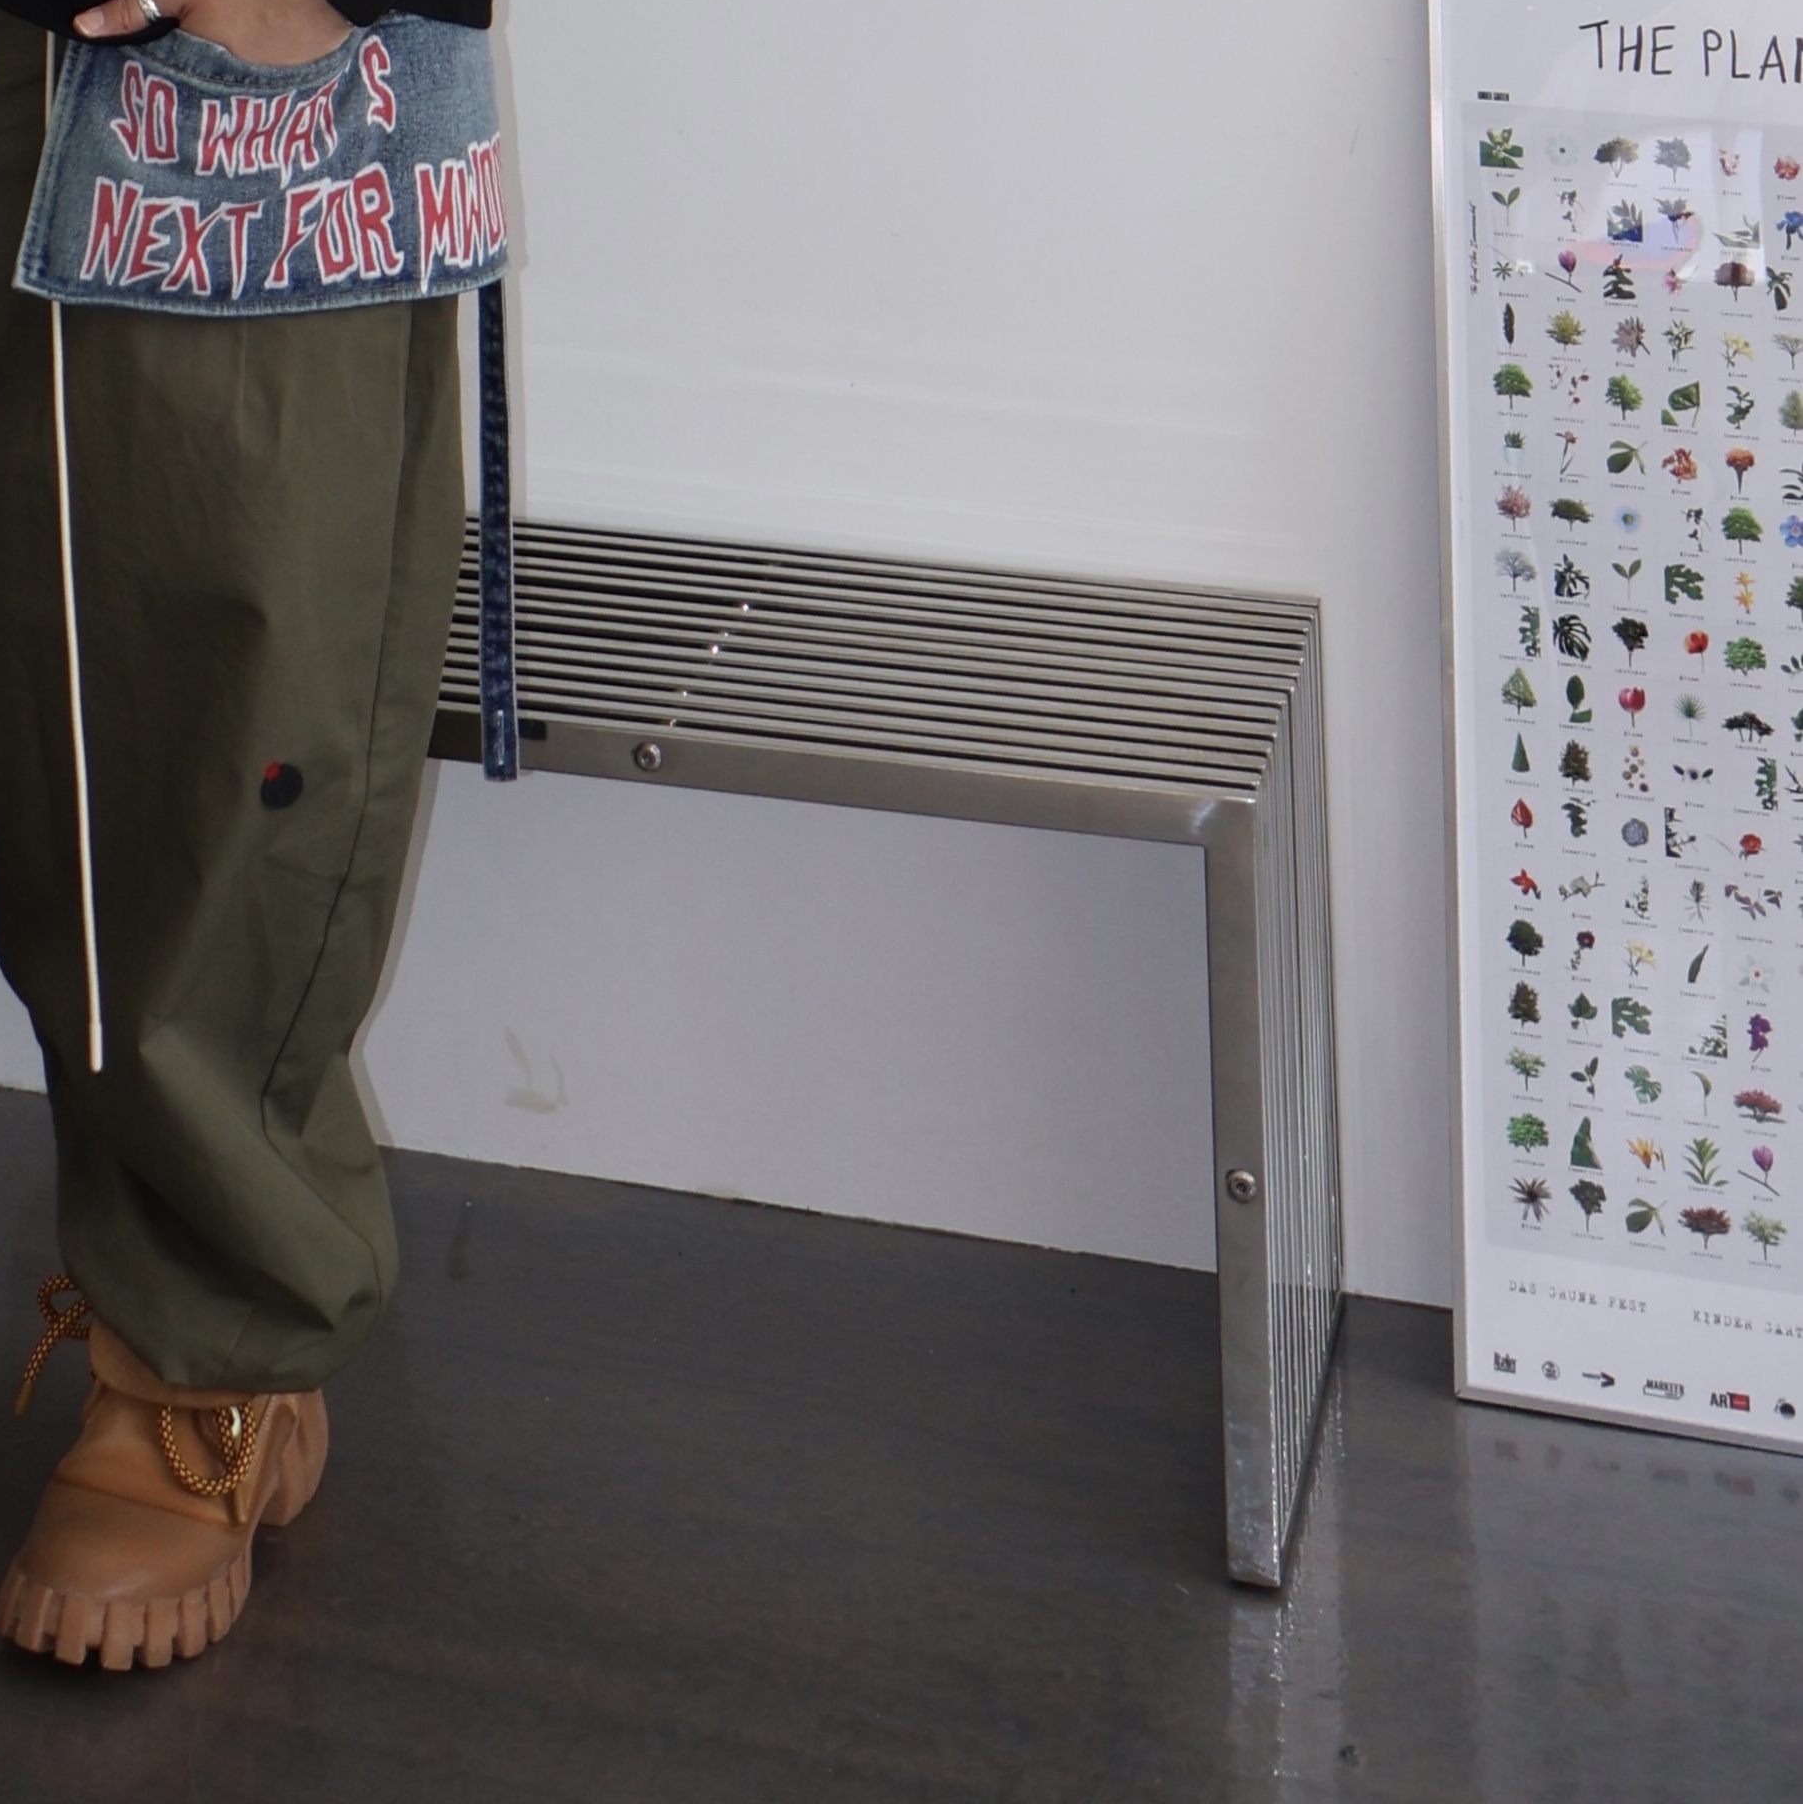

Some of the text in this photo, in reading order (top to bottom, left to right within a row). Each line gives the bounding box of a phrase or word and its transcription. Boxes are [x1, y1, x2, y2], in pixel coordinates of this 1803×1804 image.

[1578, 19, 1676, 76] THE
[109, 60, 179, 164] SO
[80, 131, 508, 300] NEXT FOR MWO
[1607, 1295, 1647, 1313] FEST
